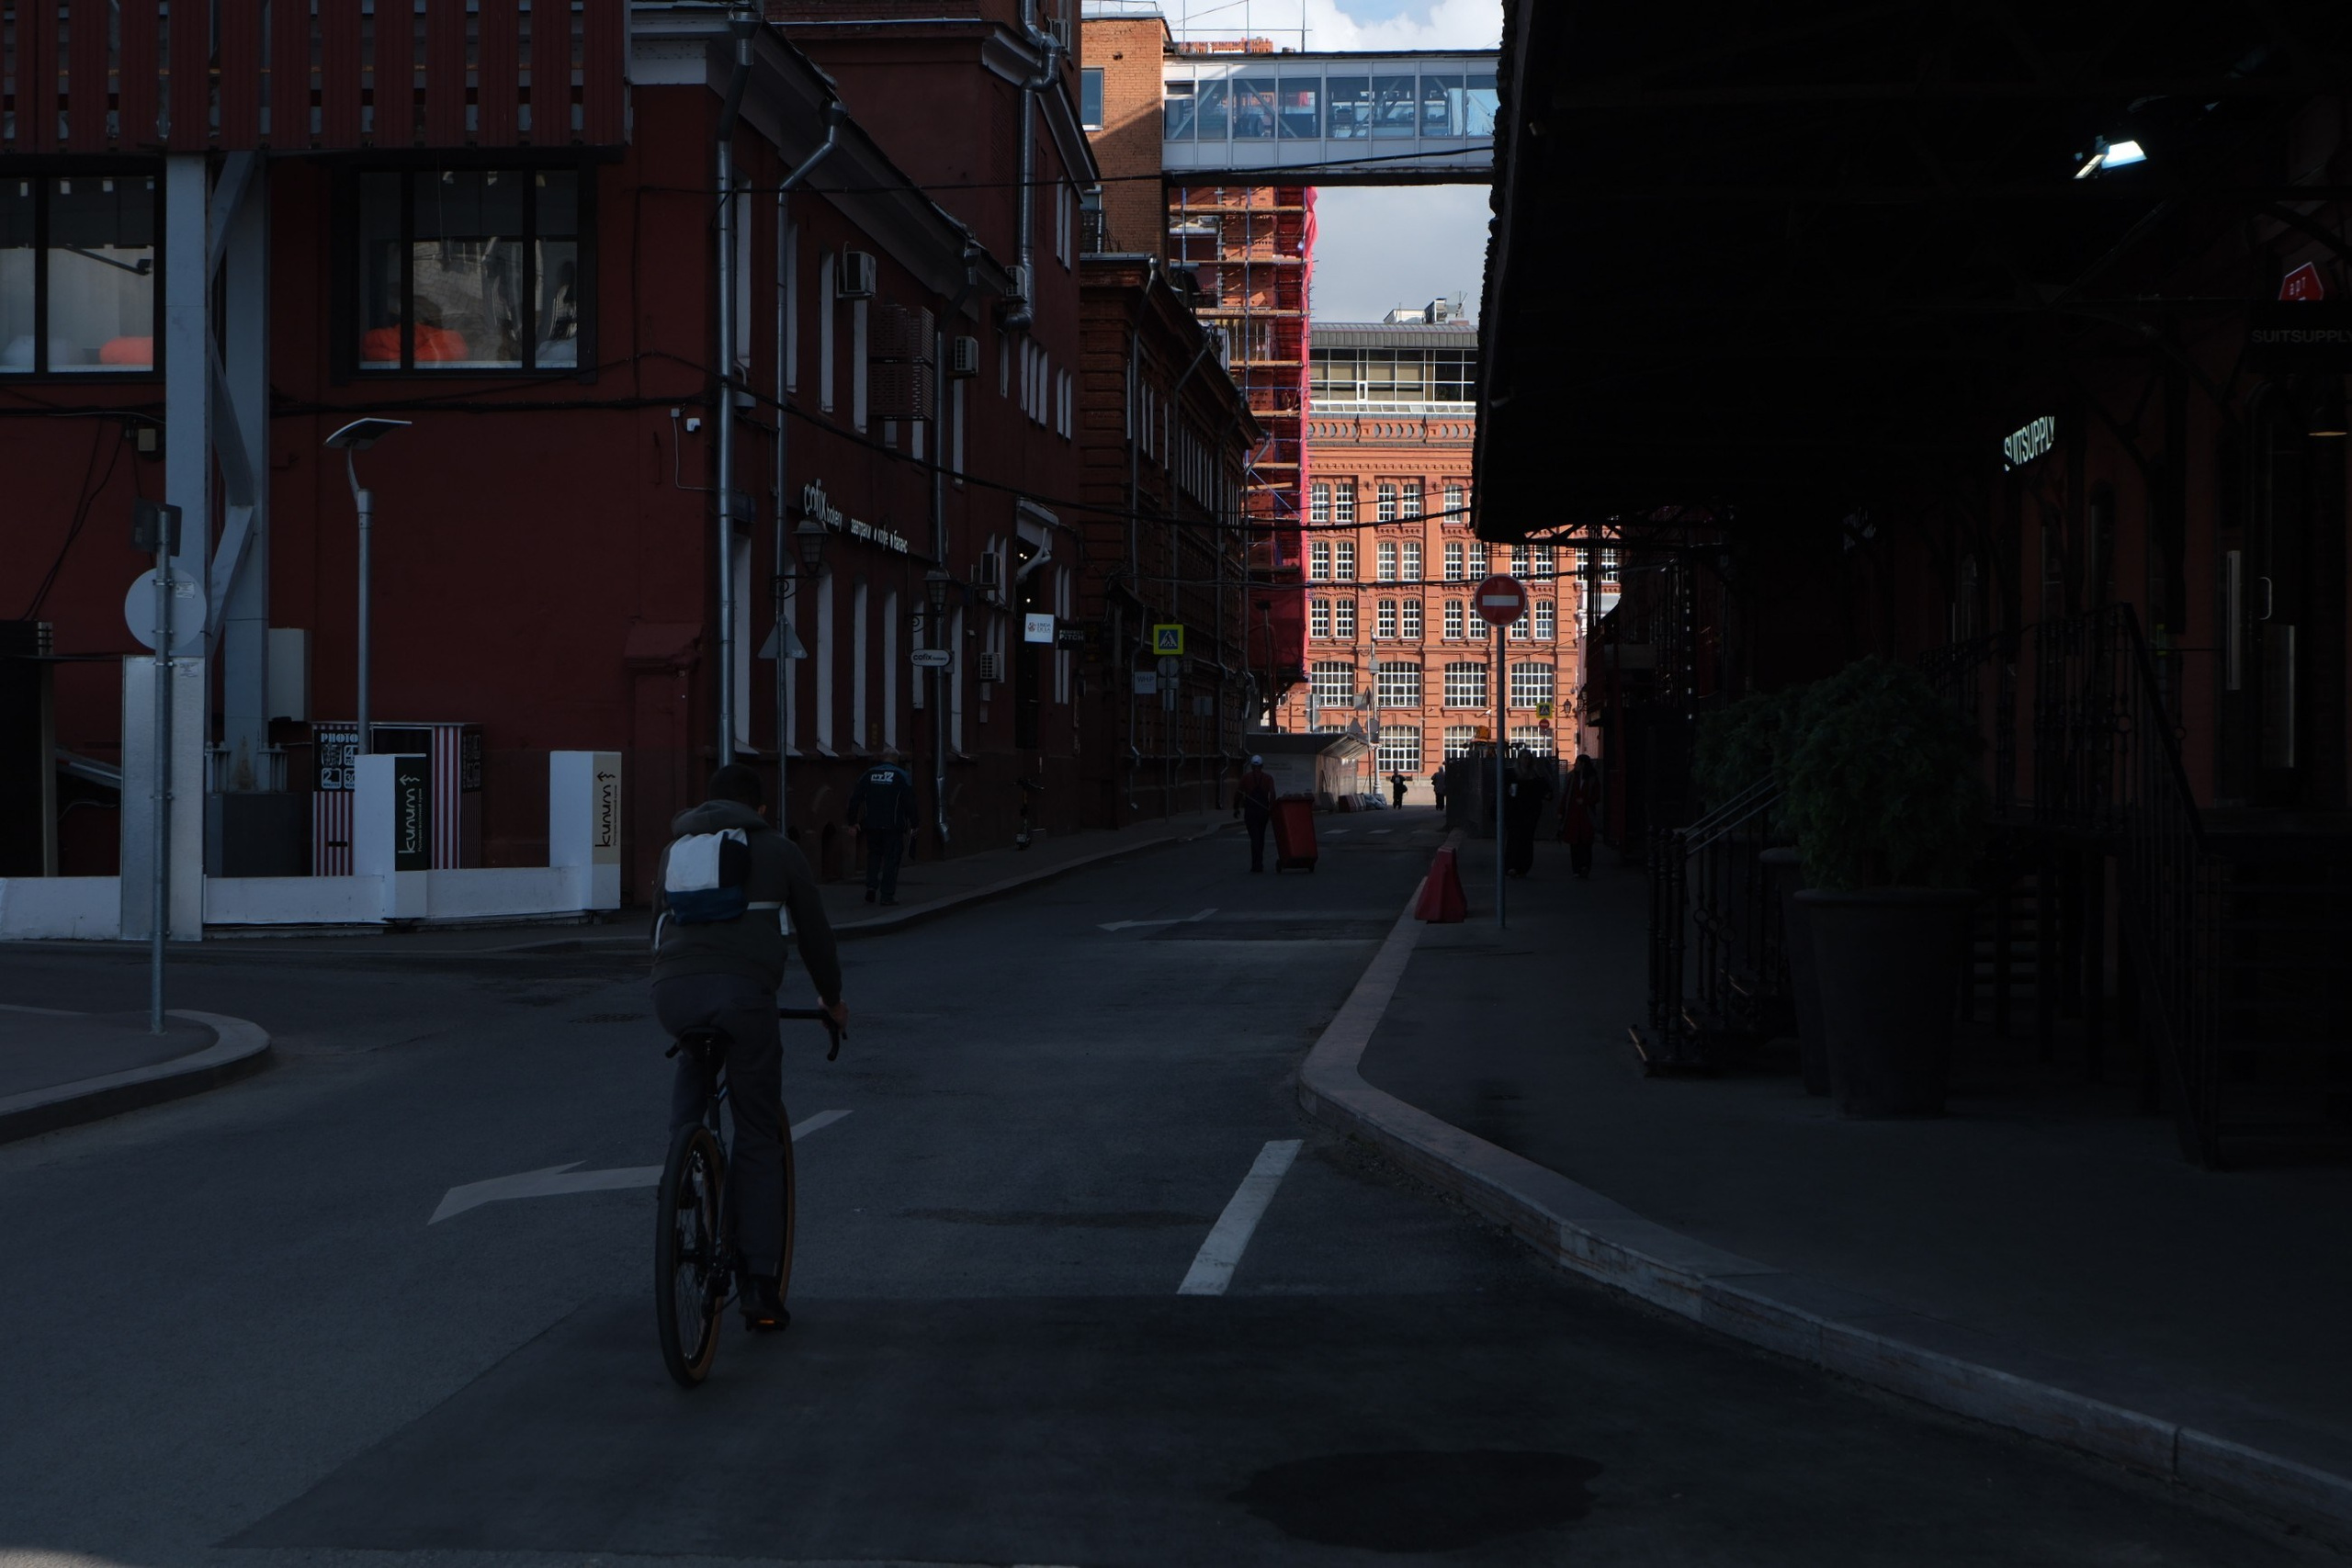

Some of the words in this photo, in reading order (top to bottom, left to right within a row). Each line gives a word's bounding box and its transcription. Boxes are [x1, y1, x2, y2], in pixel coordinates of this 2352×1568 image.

[2004, 415, 2055, 471] SUITSUPPLY
[804, 478, 827, 522] cofix
[320, 732, 359, 744] PHOTO
